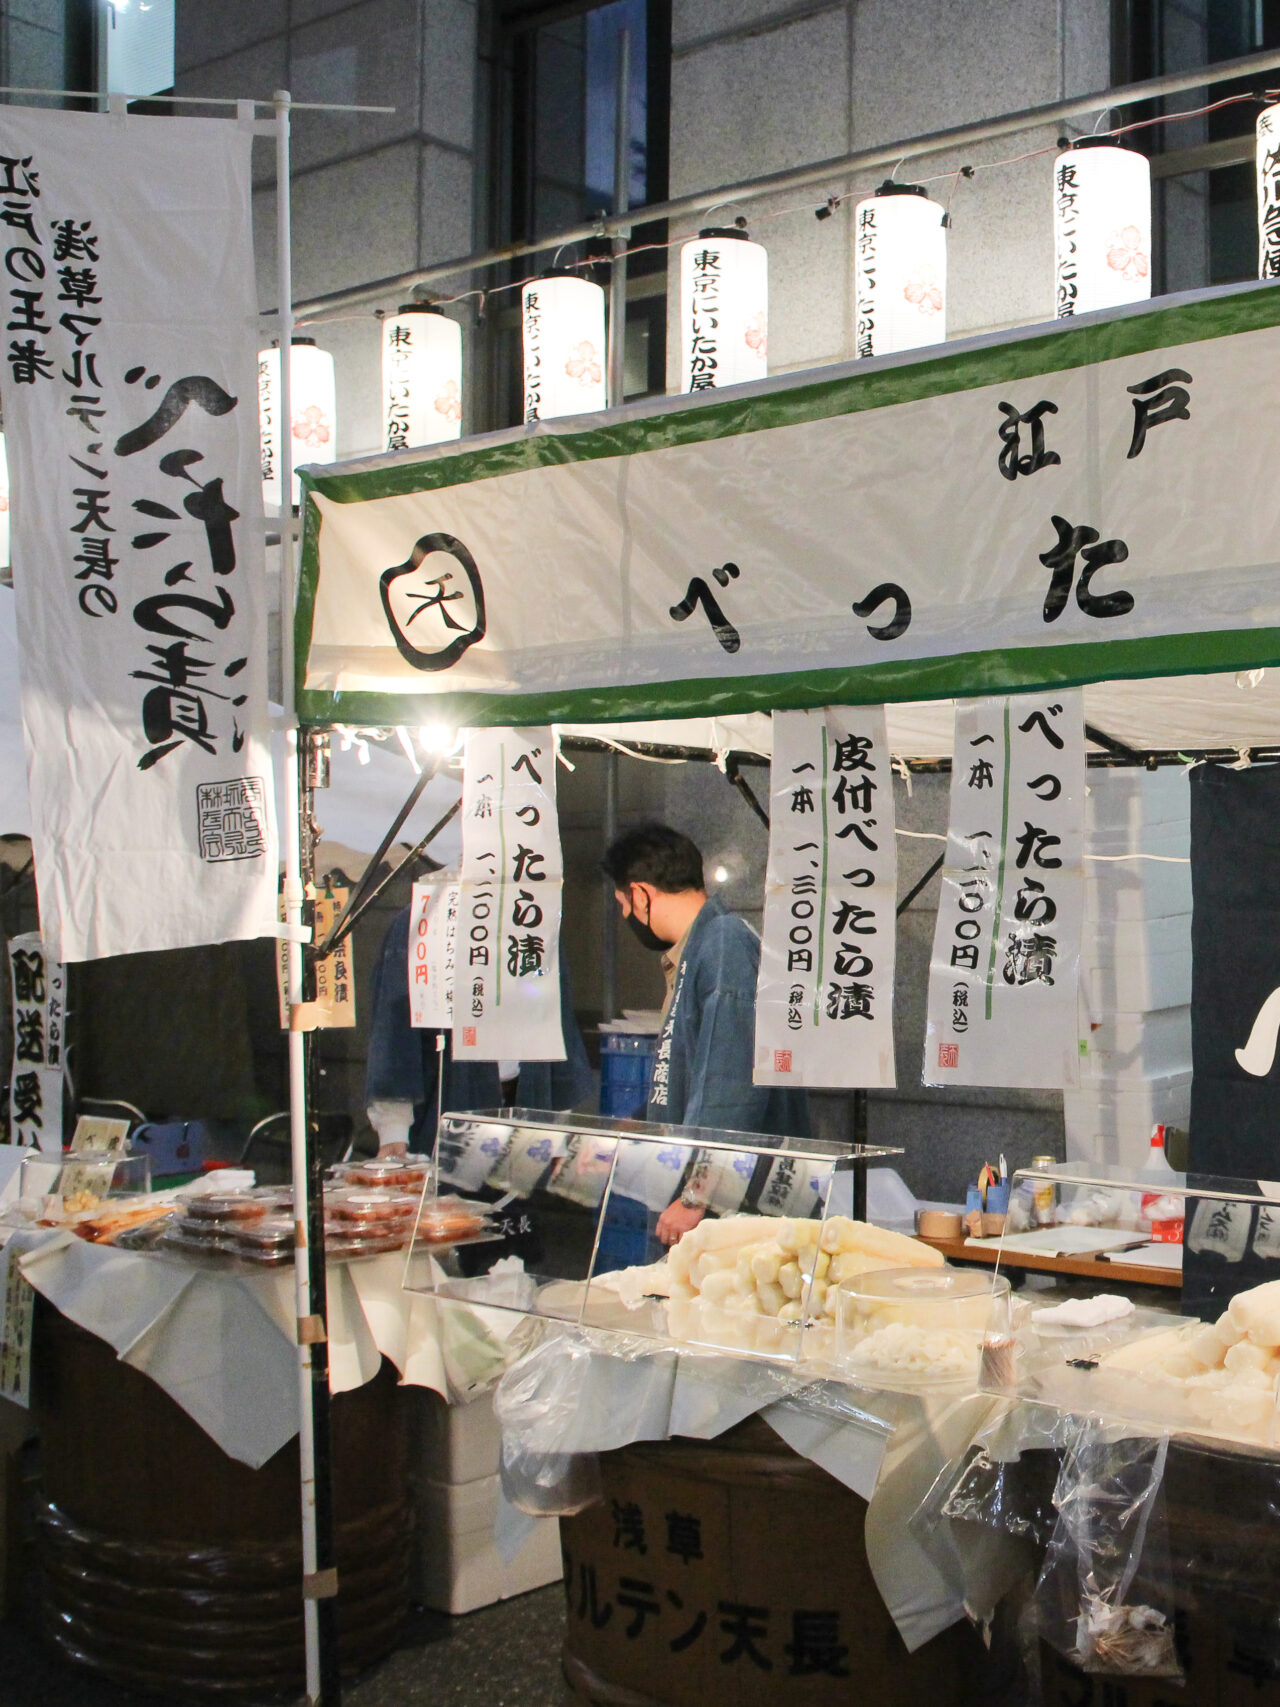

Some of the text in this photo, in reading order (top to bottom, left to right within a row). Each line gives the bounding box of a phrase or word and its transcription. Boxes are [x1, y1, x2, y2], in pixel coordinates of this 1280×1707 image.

[690, 249, 722, 394] 東京にいたか屋
[998, 367, 1193, 482] 江戸
[507, 748, 547, 977] べったら漬
[825, 733, 878, 1022] 皮付べったら漬
[1003, 703, 1065, 987] べったら漬
[415, 895, 431, 985] 700円
[611, 1497, 705, 1566] 浅草
